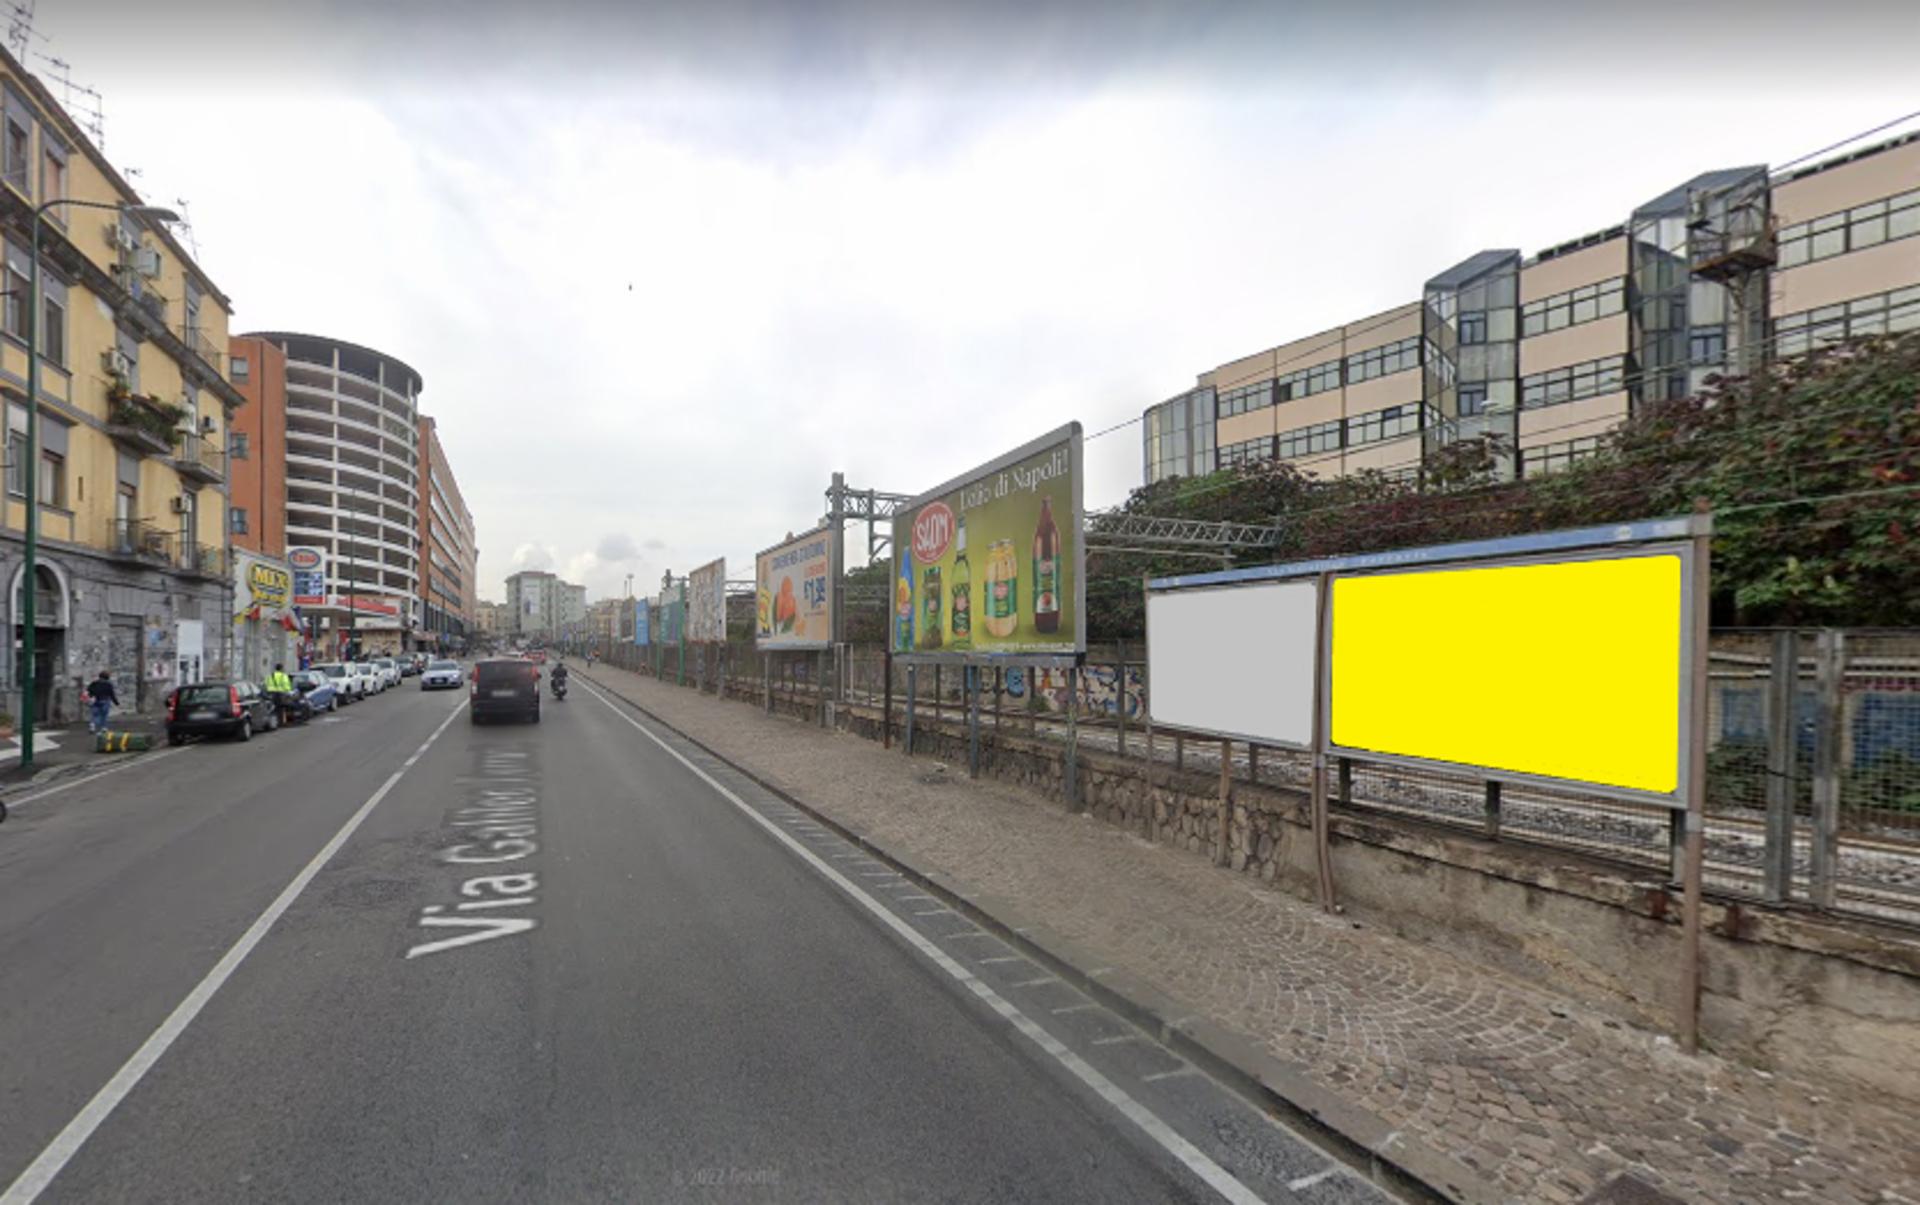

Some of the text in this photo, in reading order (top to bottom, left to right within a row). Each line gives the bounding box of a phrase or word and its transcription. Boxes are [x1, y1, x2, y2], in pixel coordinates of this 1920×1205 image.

[995, 473, 1008, 498] di
[1012, 449, 1068, 494] Napoli!
[405, 873, 538, 959] Via
